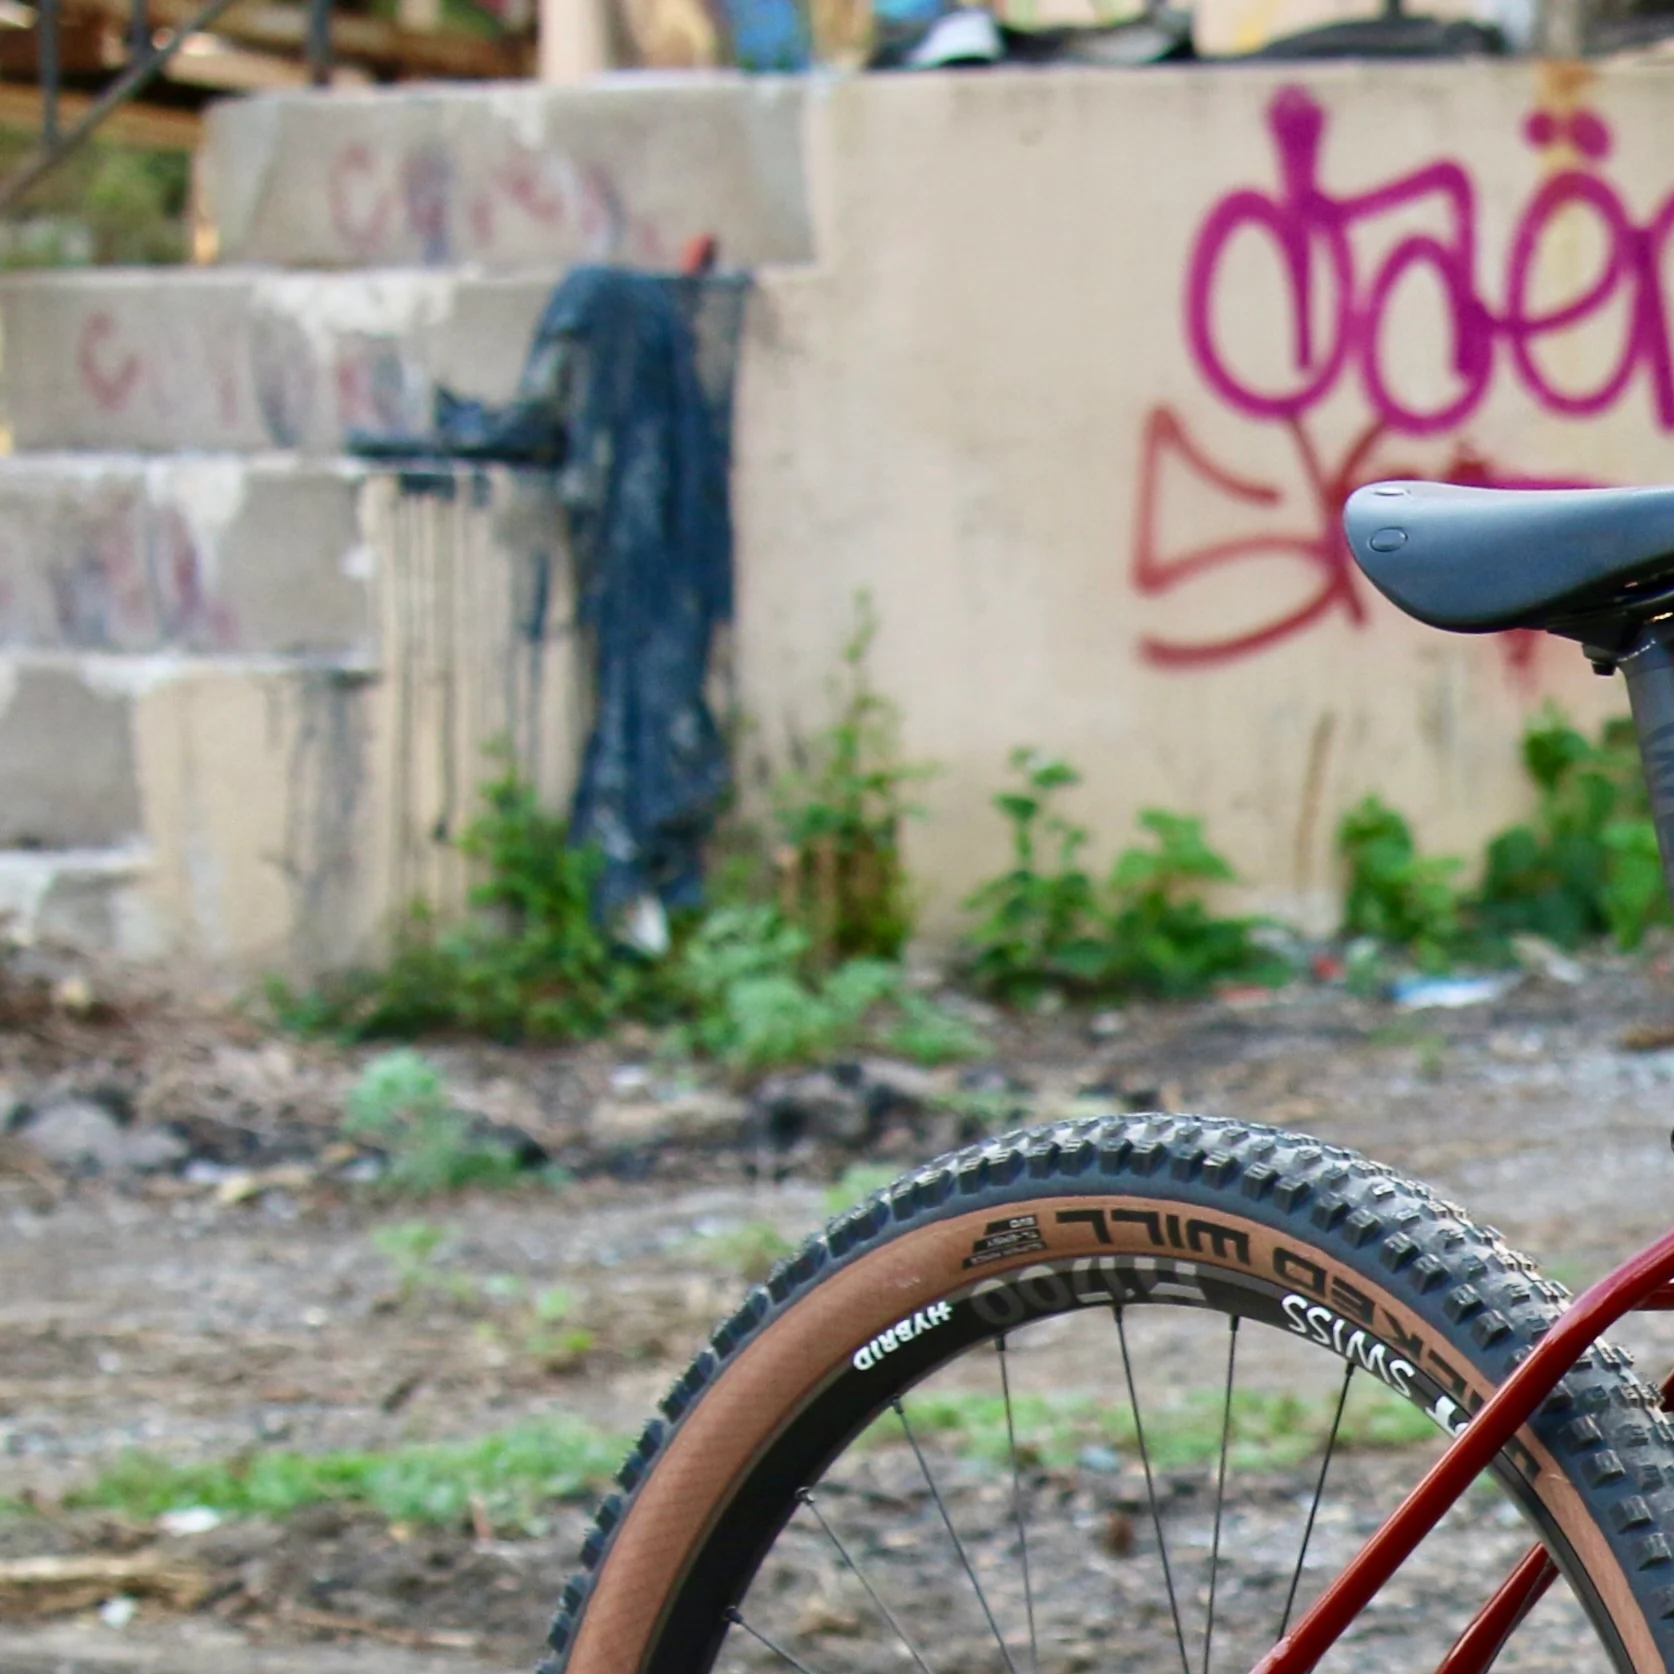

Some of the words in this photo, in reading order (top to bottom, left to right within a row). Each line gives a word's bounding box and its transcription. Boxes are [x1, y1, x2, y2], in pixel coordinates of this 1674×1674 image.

[1055, 1208, 1251, 1267] WILL
[852, 1299, 953, 1372] HYBRID
[1280, 1294, 1416, 1398] SWISS
